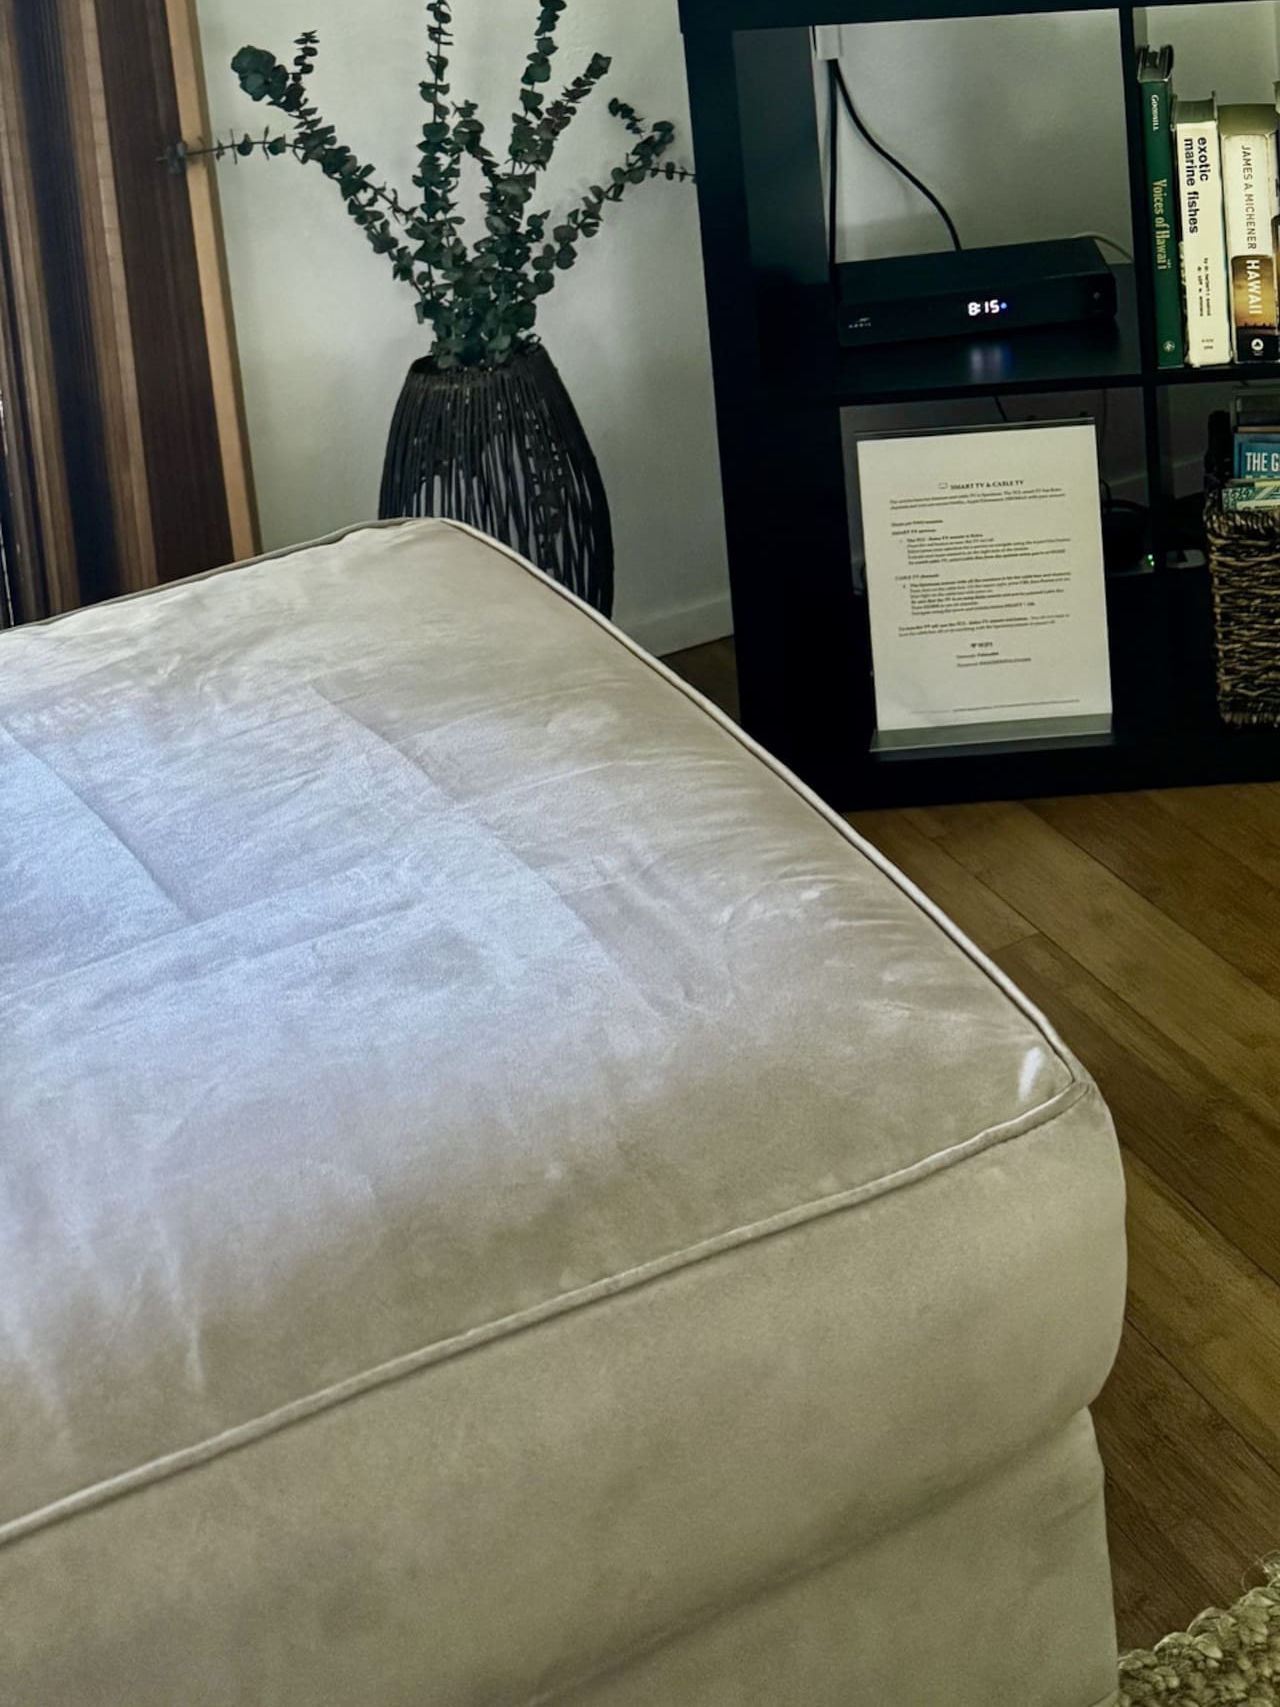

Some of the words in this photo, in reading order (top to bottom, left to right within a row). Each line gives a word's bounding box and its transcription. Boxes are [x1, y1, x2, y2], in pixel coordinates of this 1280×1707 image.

[1183, 138, 1197, 187] marine
[1197, 137, 1212, 182] exotic
[1241, 145, 1254, 181] JAMES
[1153, 179, 1168, 214] Voices
[1187, 191, 1200, 234] fishes
[1155, 217, 1170, 228] of
[1245, 193, 1258, 250] MICHENER
[1246, 259, 1263, 314] HAWAII
[967, 299, 1000, 316] 8:15
[1246, 452, 1268, 472] THE
